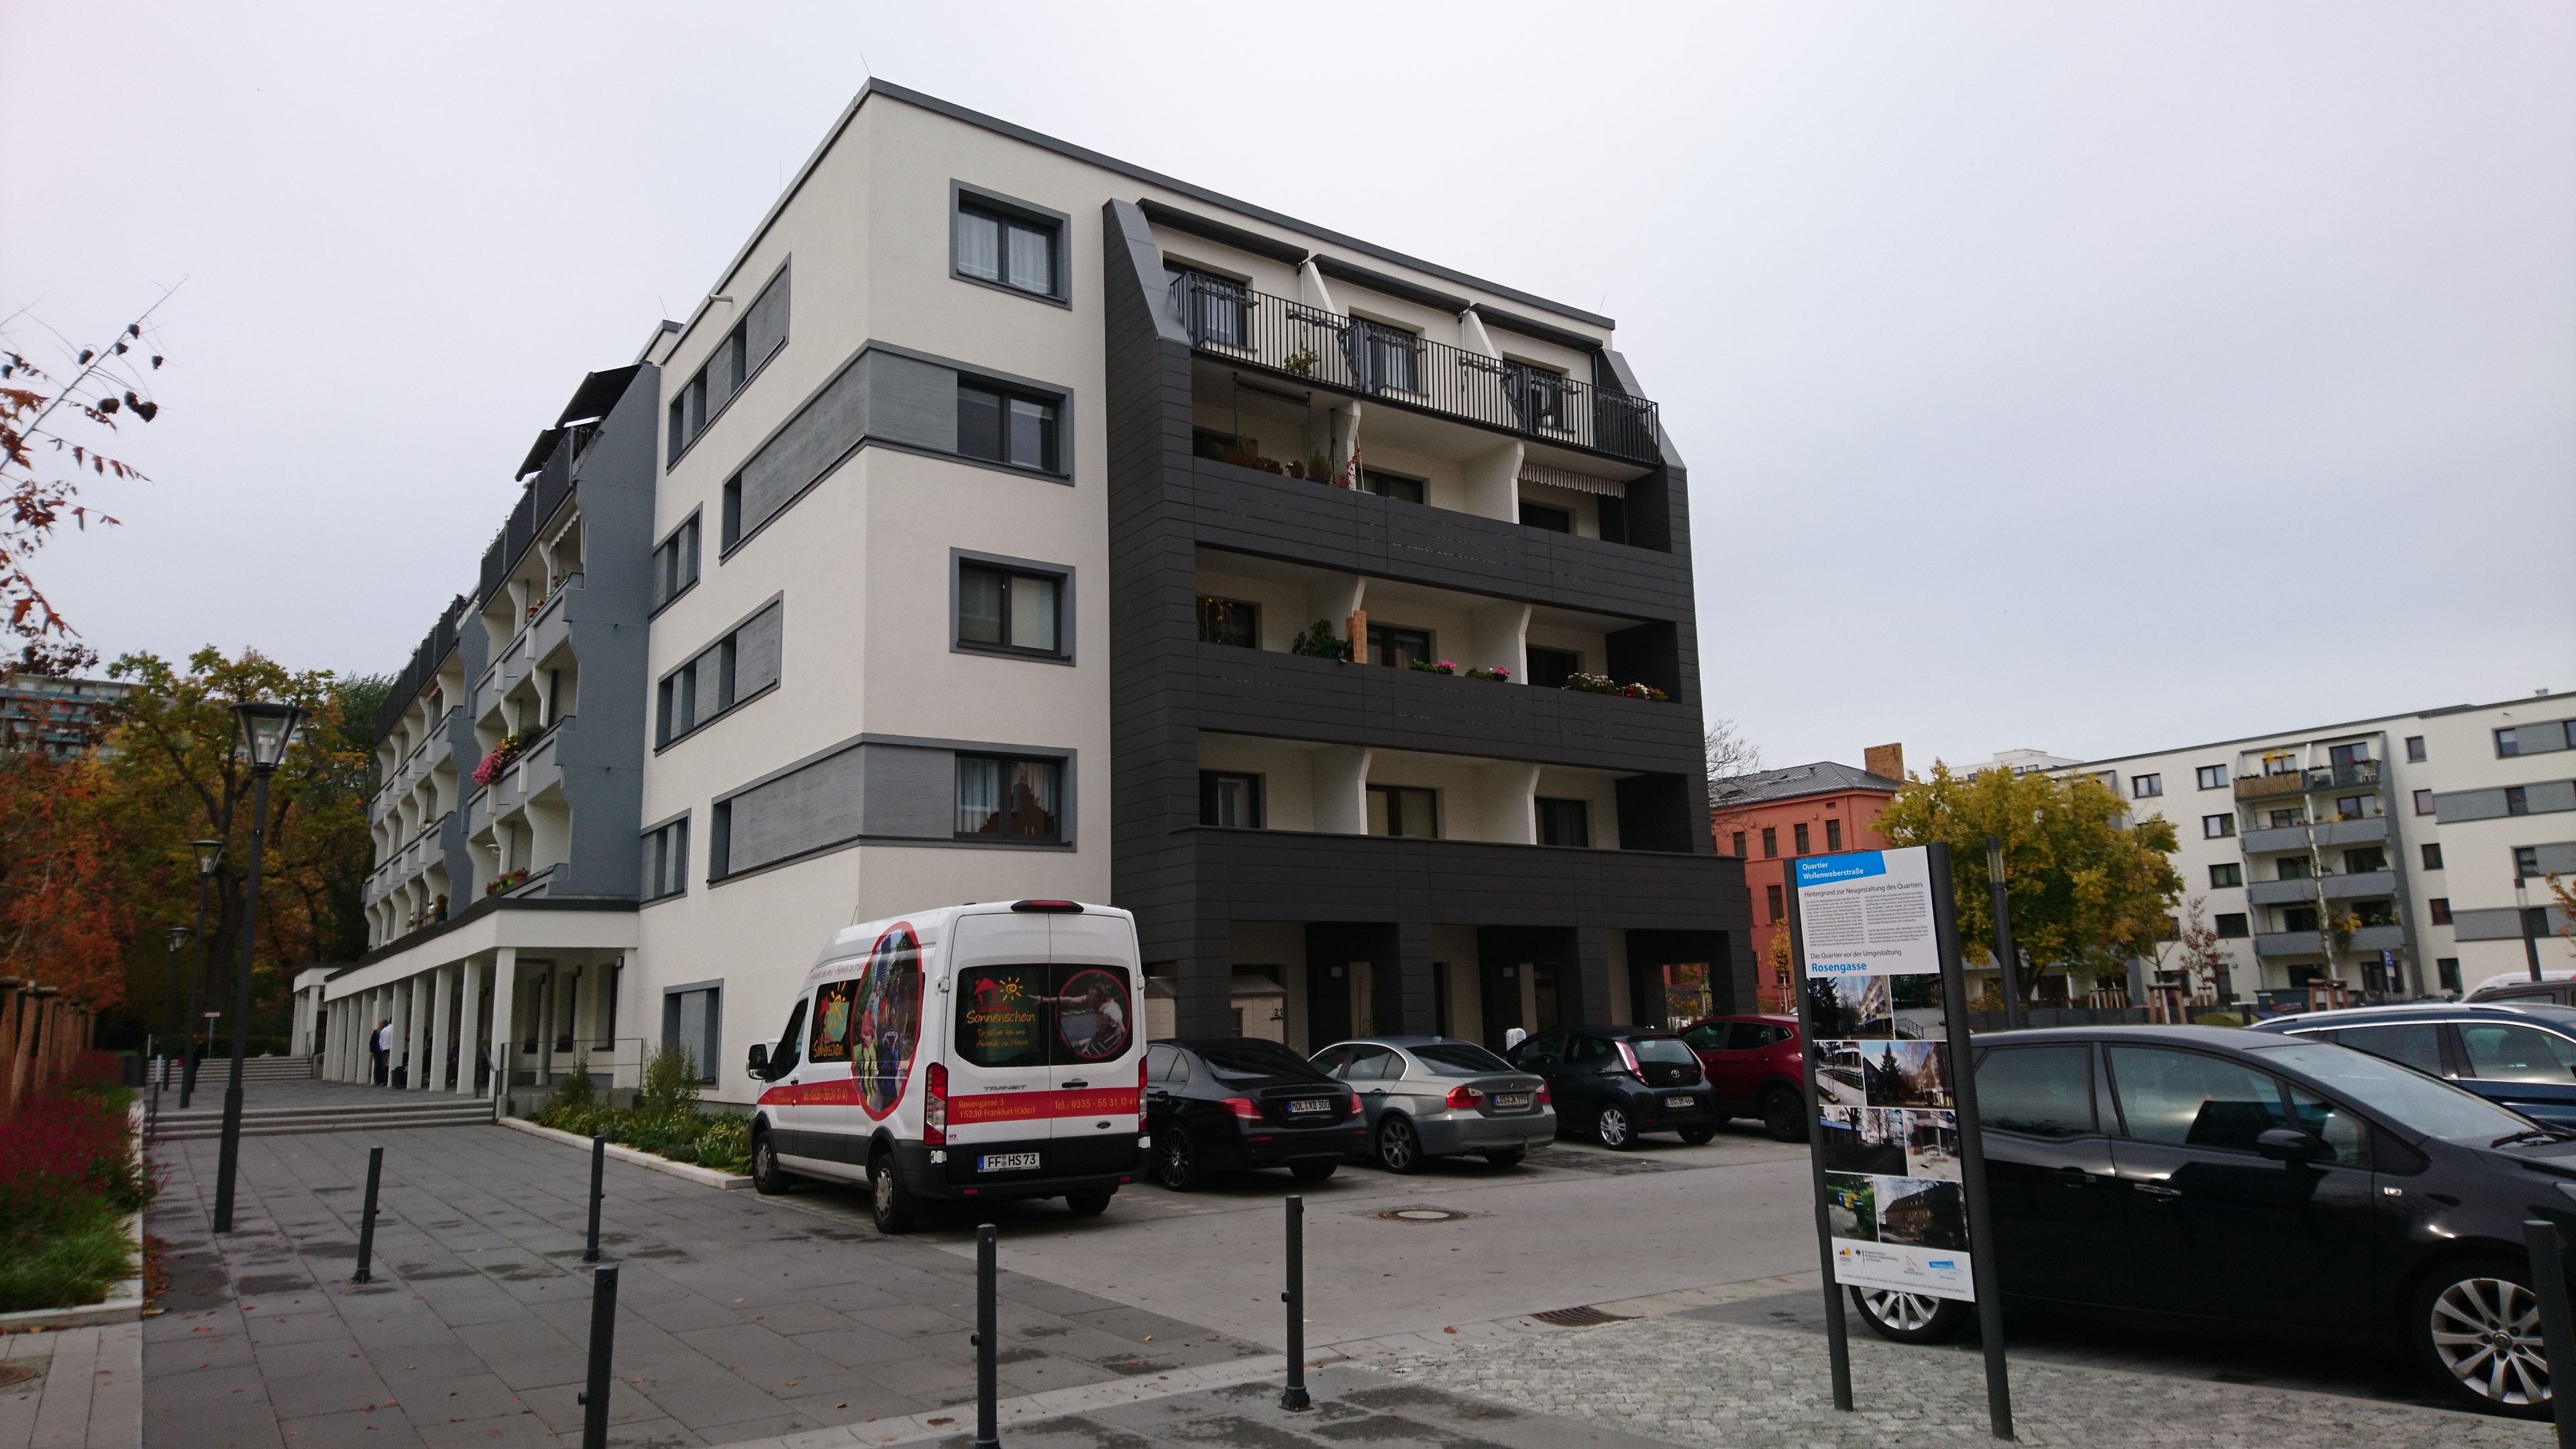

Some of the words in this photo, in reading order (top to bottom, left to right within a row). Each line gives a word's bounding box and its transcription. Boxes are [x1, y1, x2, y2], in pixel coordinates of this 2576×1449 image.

[1802, 862, 1828, 871] Quartier
[1803, 867, 1864, 879] Wollenweberstraße
[1805, 890, 1835, 898] Hintergrund
[1846, 885, 1885, 894] Neugestaltung
[1863, 949, 1902, 957] Umgestaltung
[1811, 963, 1867, 973] Rosengasse
[967, 1010, 1036, 1024] Sonnenschein
[1274, 1008, 1283, 1016] 21
[959, 1099, 998, 1108] Rosengasse
[1054, 1100, 1069, 1109] Tel.:
[1071, 1099, 1091, 1109] 0335
[1097, 1098, 1108, 1107] 55
[1109, 1098, 1118, 1106] 31
[1120, 1097, 1127, 1106] 17
[1129, 1097, 1136, 1106] 41
[1497, 1095, 1507, 1104] LOS
[1510, 1095, 1517, 1104] JK
[1517, 1095, 1527, 1104] 999
[960, 1110, 982, 1118] 15230
[984, 1108, 1013, 1117] Frankfurt
[1014, 1106, 1036, 1116] (Oder)
[1292, 1102, 1305, 1112] MOL
[1309, 1102, 1317, 1110] XD
[1318, 1101, 1330, 1110] 300
[988, 1156, 1002, 1167] FF
[1008, 1155, 1022, 1166] HS
[1024, 1155, 1036, 1165] 73
